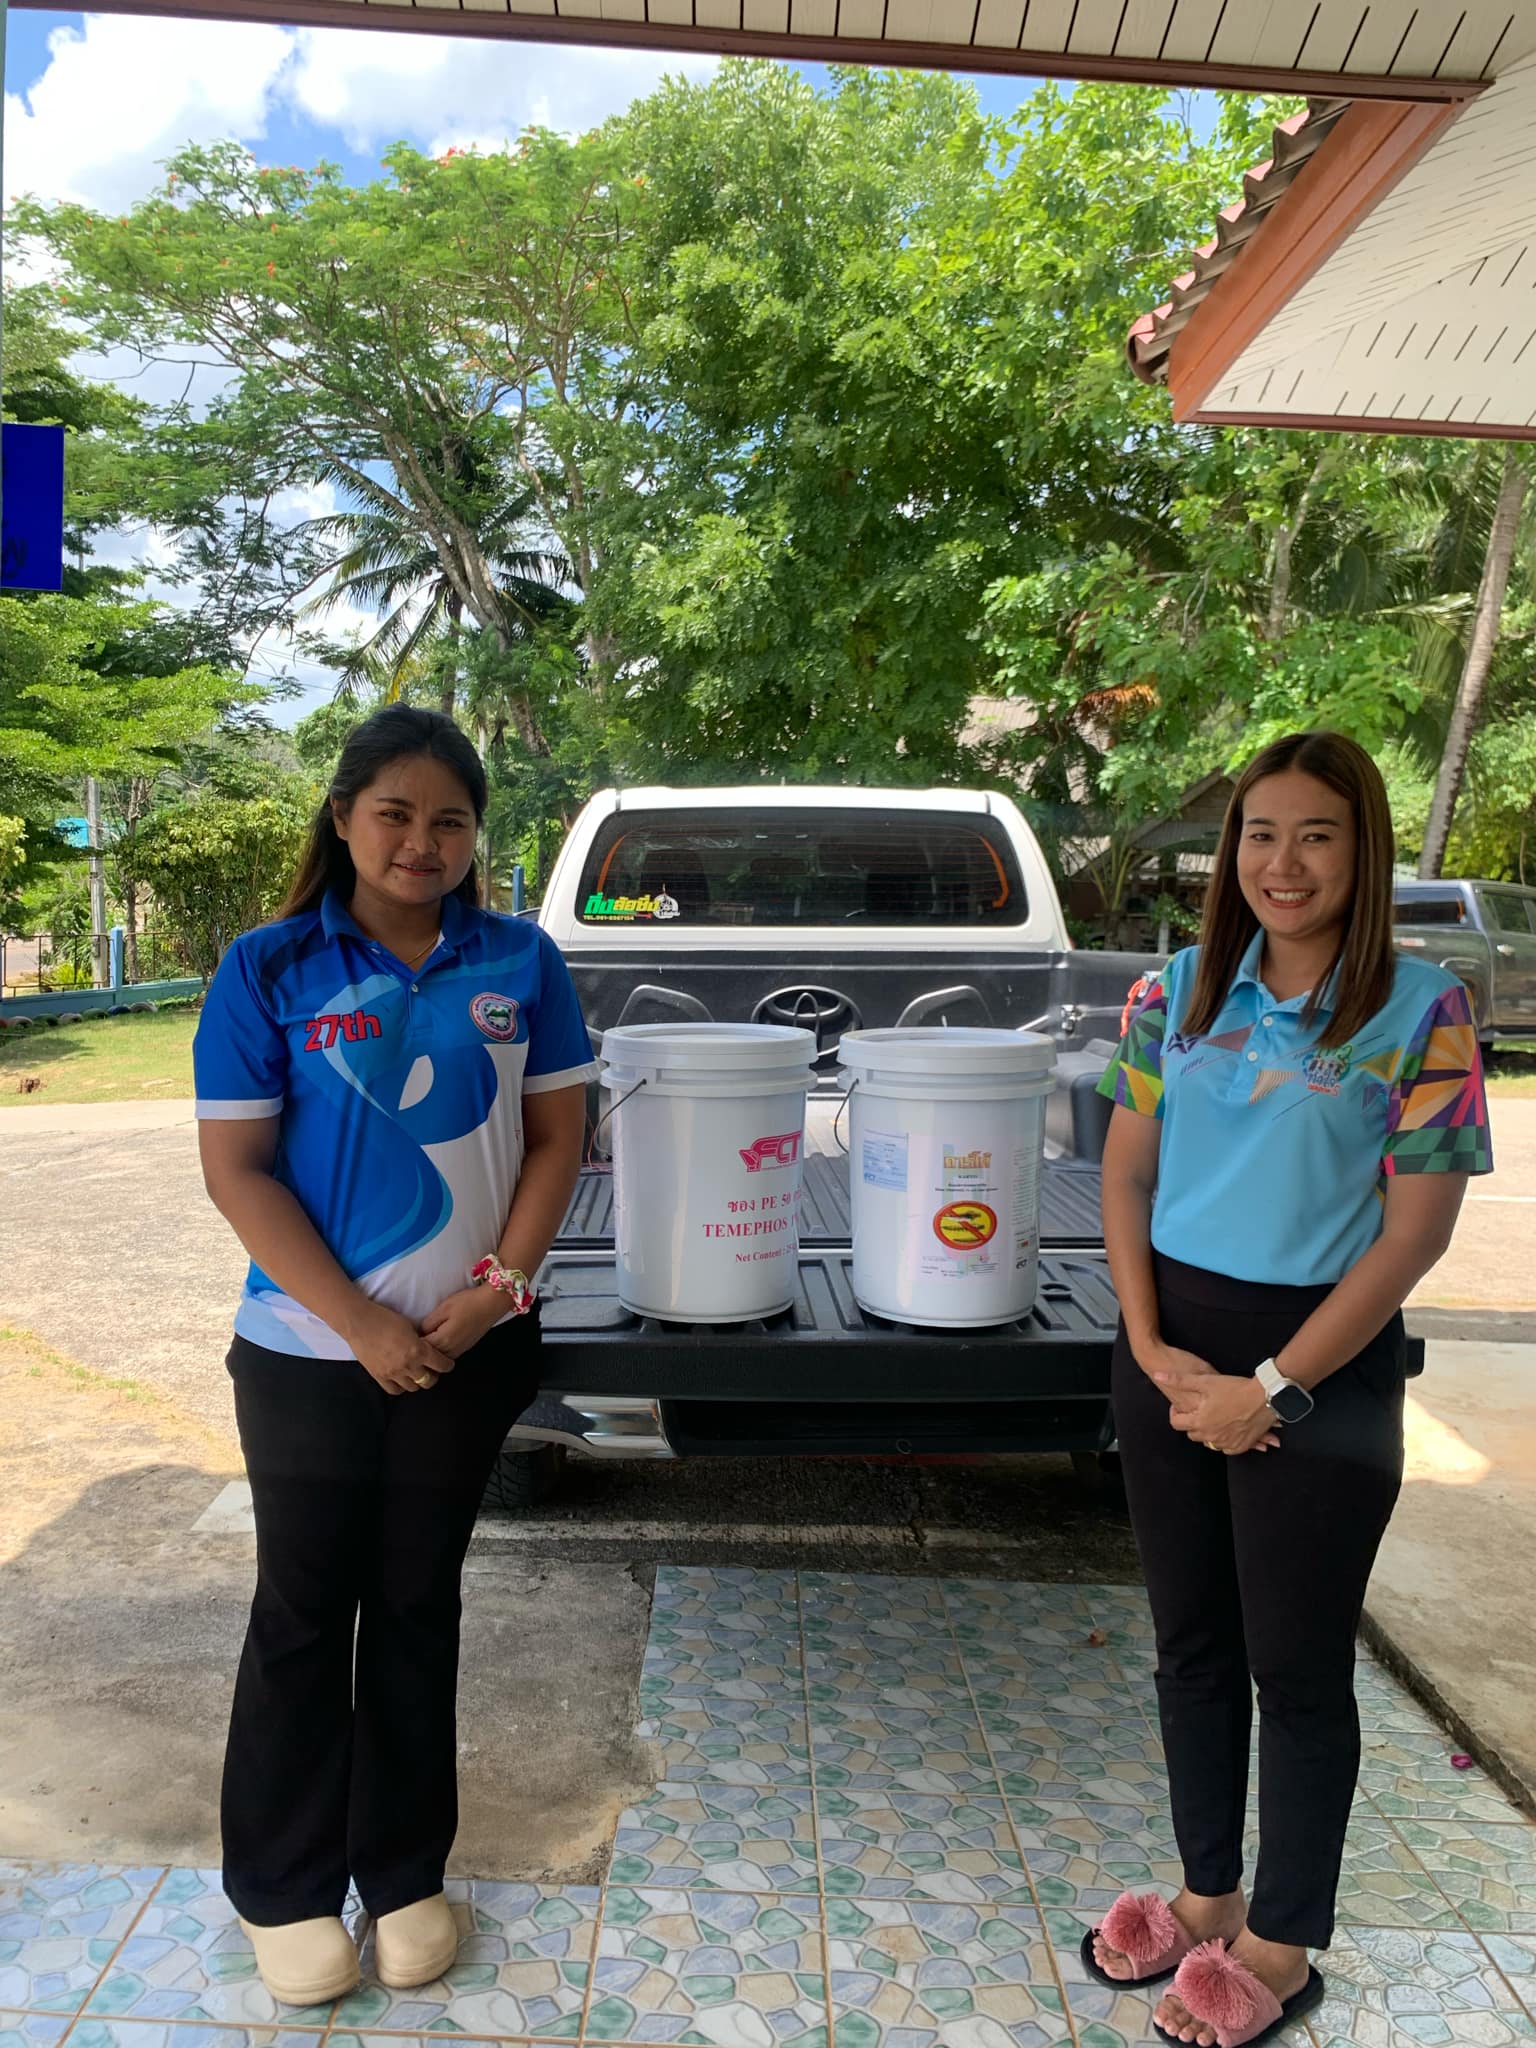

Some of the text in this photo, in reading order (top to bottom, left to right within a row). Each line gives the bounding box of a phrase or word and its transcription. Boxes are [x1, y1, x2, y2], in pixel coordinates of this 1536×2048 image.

[304, 1009, 382, 1052] 27th
[728, 1199, 756, 1213] ซอง
[761, 1195, 778, 1210] PE
[703, 1217, 788, 1238] TEMEPHOS
[736, 1252, 751, 1263] Net
